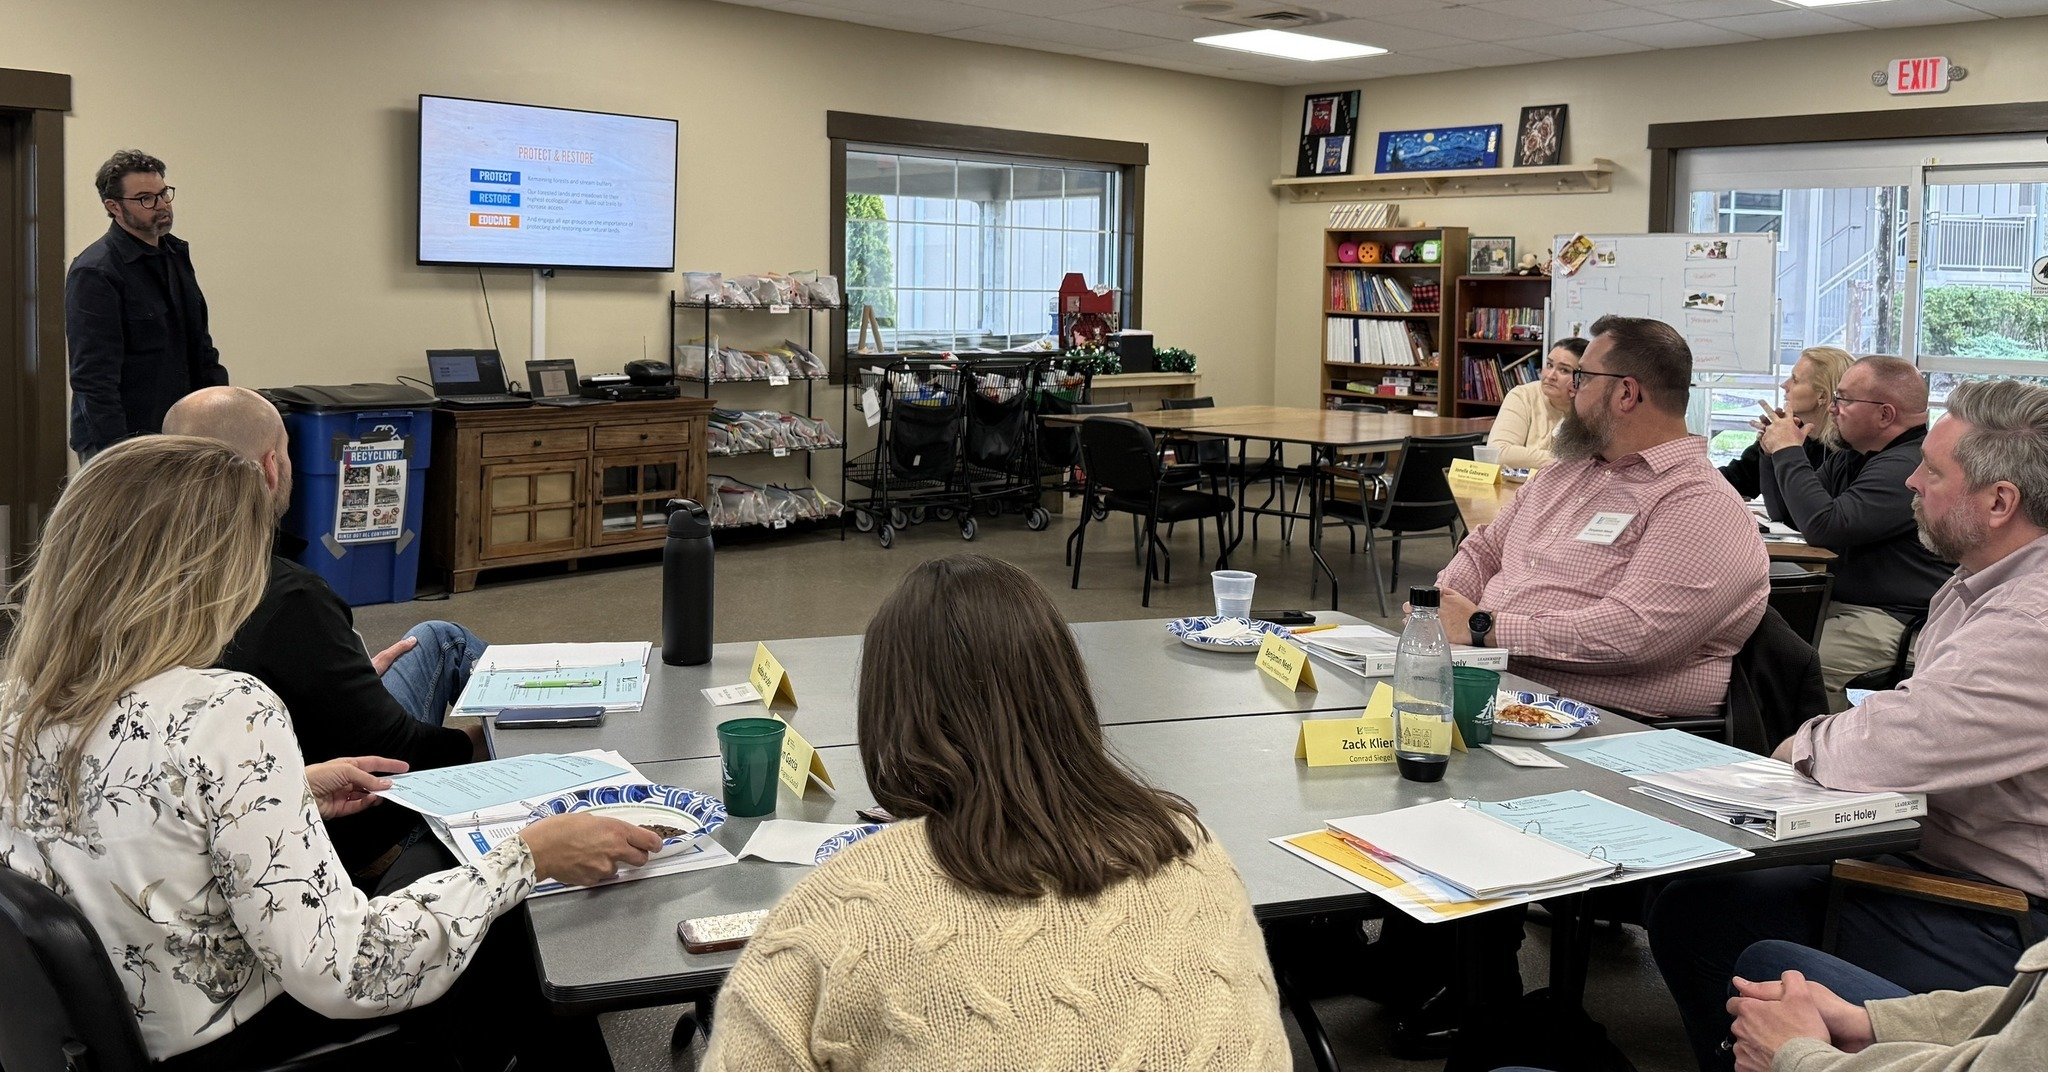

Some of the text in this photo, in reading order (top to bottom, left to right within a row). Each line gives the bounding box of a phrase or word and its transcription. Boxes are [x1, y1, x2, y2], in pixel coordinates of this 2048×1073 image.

[1898, 59, 1941, 91] EXIT
[518, 147, 594, 165] PROTECT & RESTORE
[479, 170, 513, 183] PROTECT
[479, 192, 512, 204] RESTORE
[478, 214, 512, 226] EDUCATE
[1342, 738, 1367, 750] Zack
[1349, 754, 1393, 763] Conrad Siegel
[1834, 809, 1877, 824] Eric Holey
